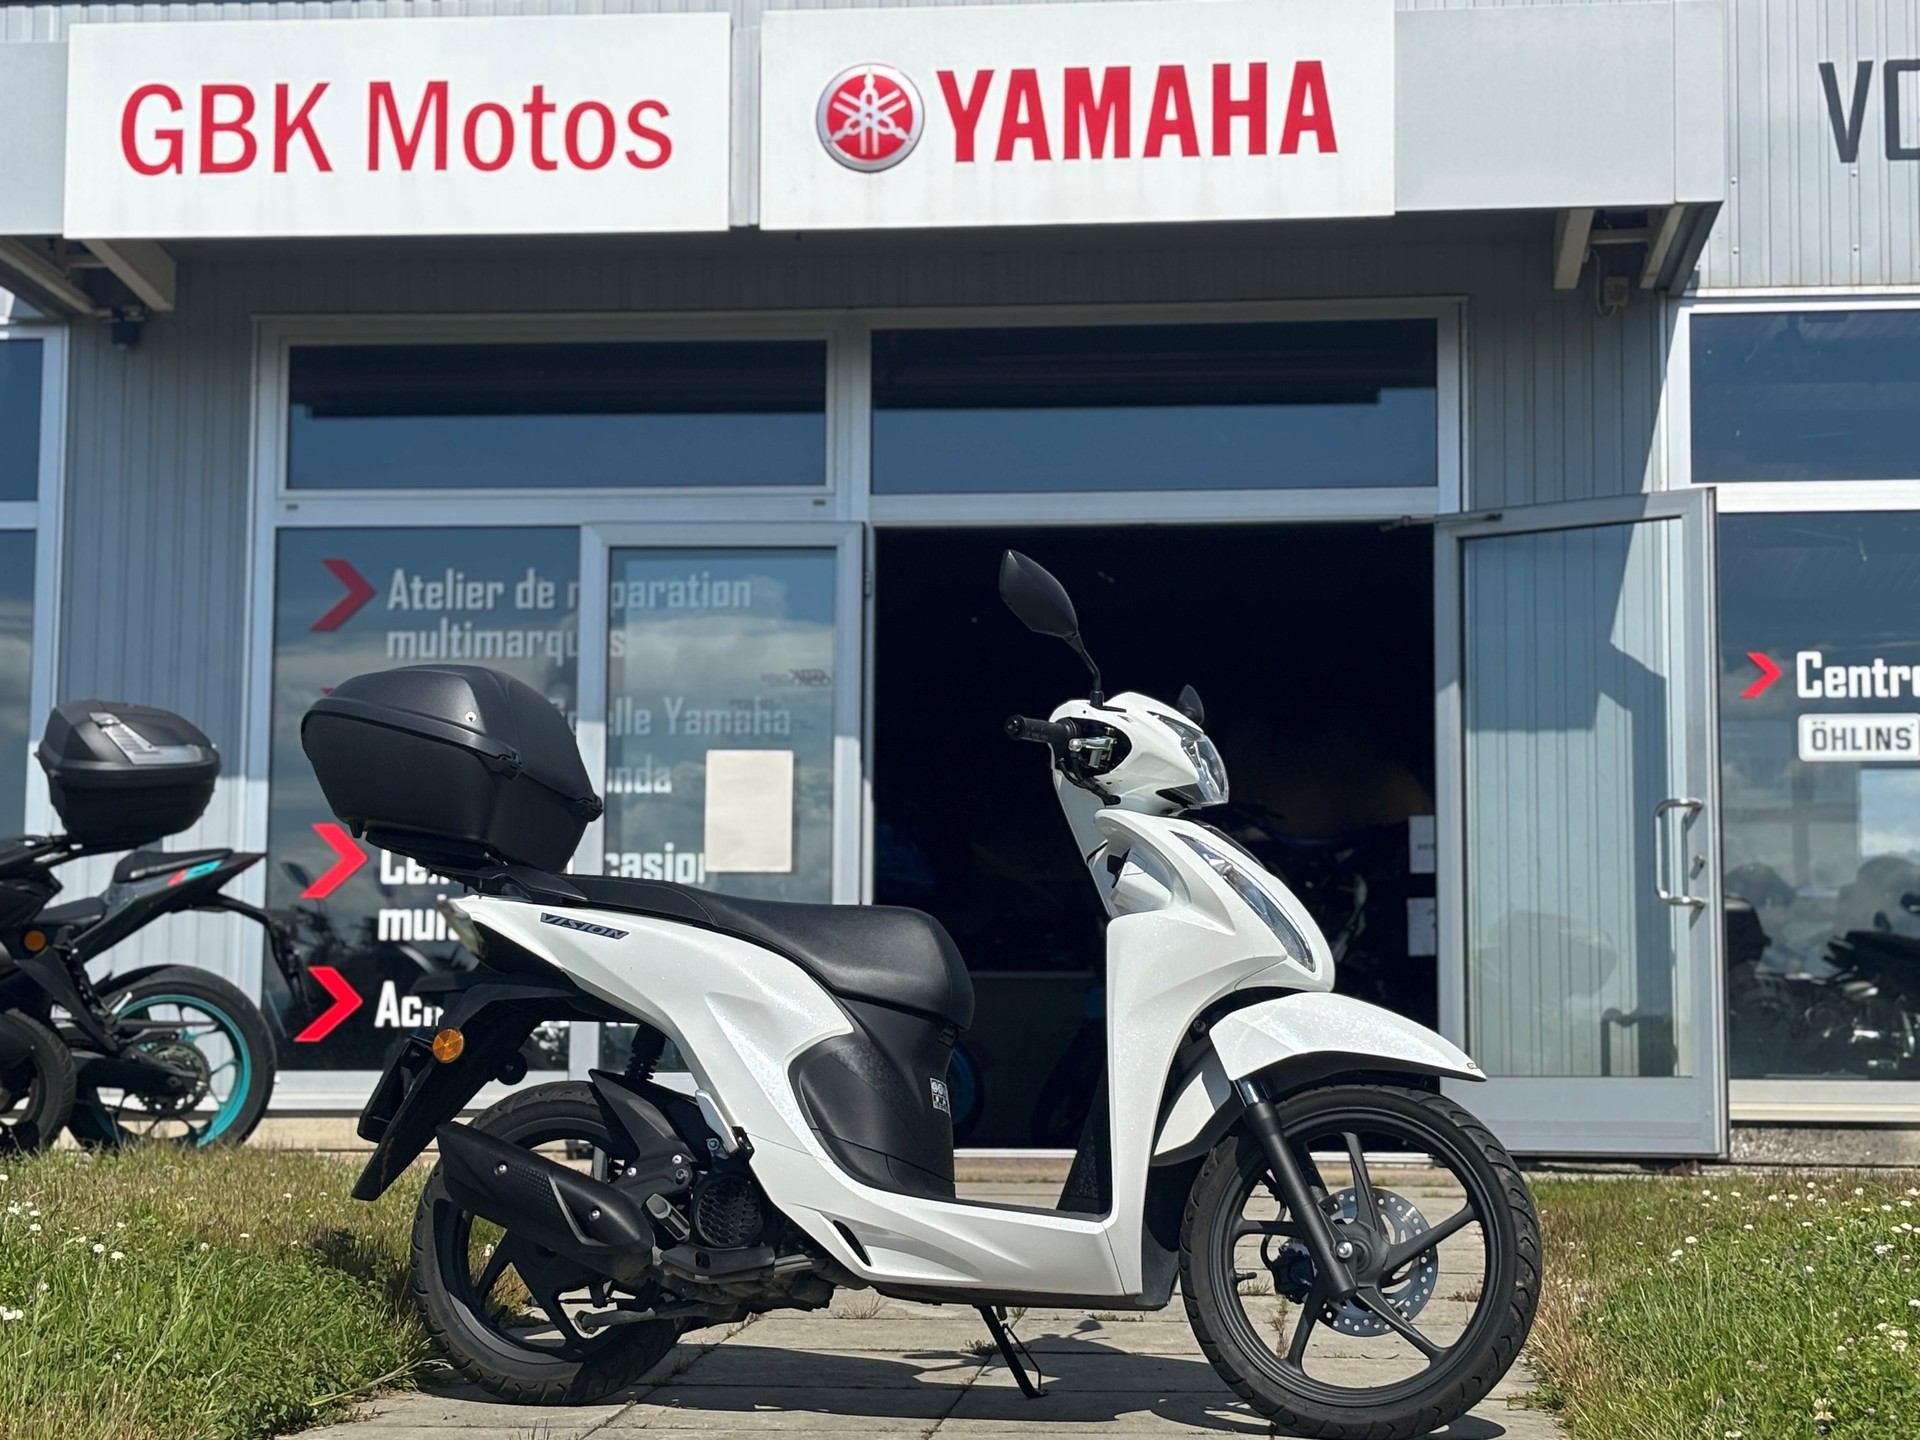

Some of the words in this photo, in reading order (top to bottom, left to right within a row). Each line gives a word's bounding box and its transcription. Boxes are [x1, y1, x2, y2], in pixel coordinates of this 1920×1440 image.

[121, 82, 333, 176] GBK
[367, 79, 674, 172] Motos
[936, 60, 1339, 163] YAMAHA
[387, 567, 505, 611] Atelier
[515, 567, 555, 610] de
[567, 571, 751, 617] rparation
[386, 616, 625, 668] multimarqus
[663, 696, 791, 735] Yamaha
[1811, 720, 1913, 752] ÖHLINS
[541, 912, 629, 939] VISION
